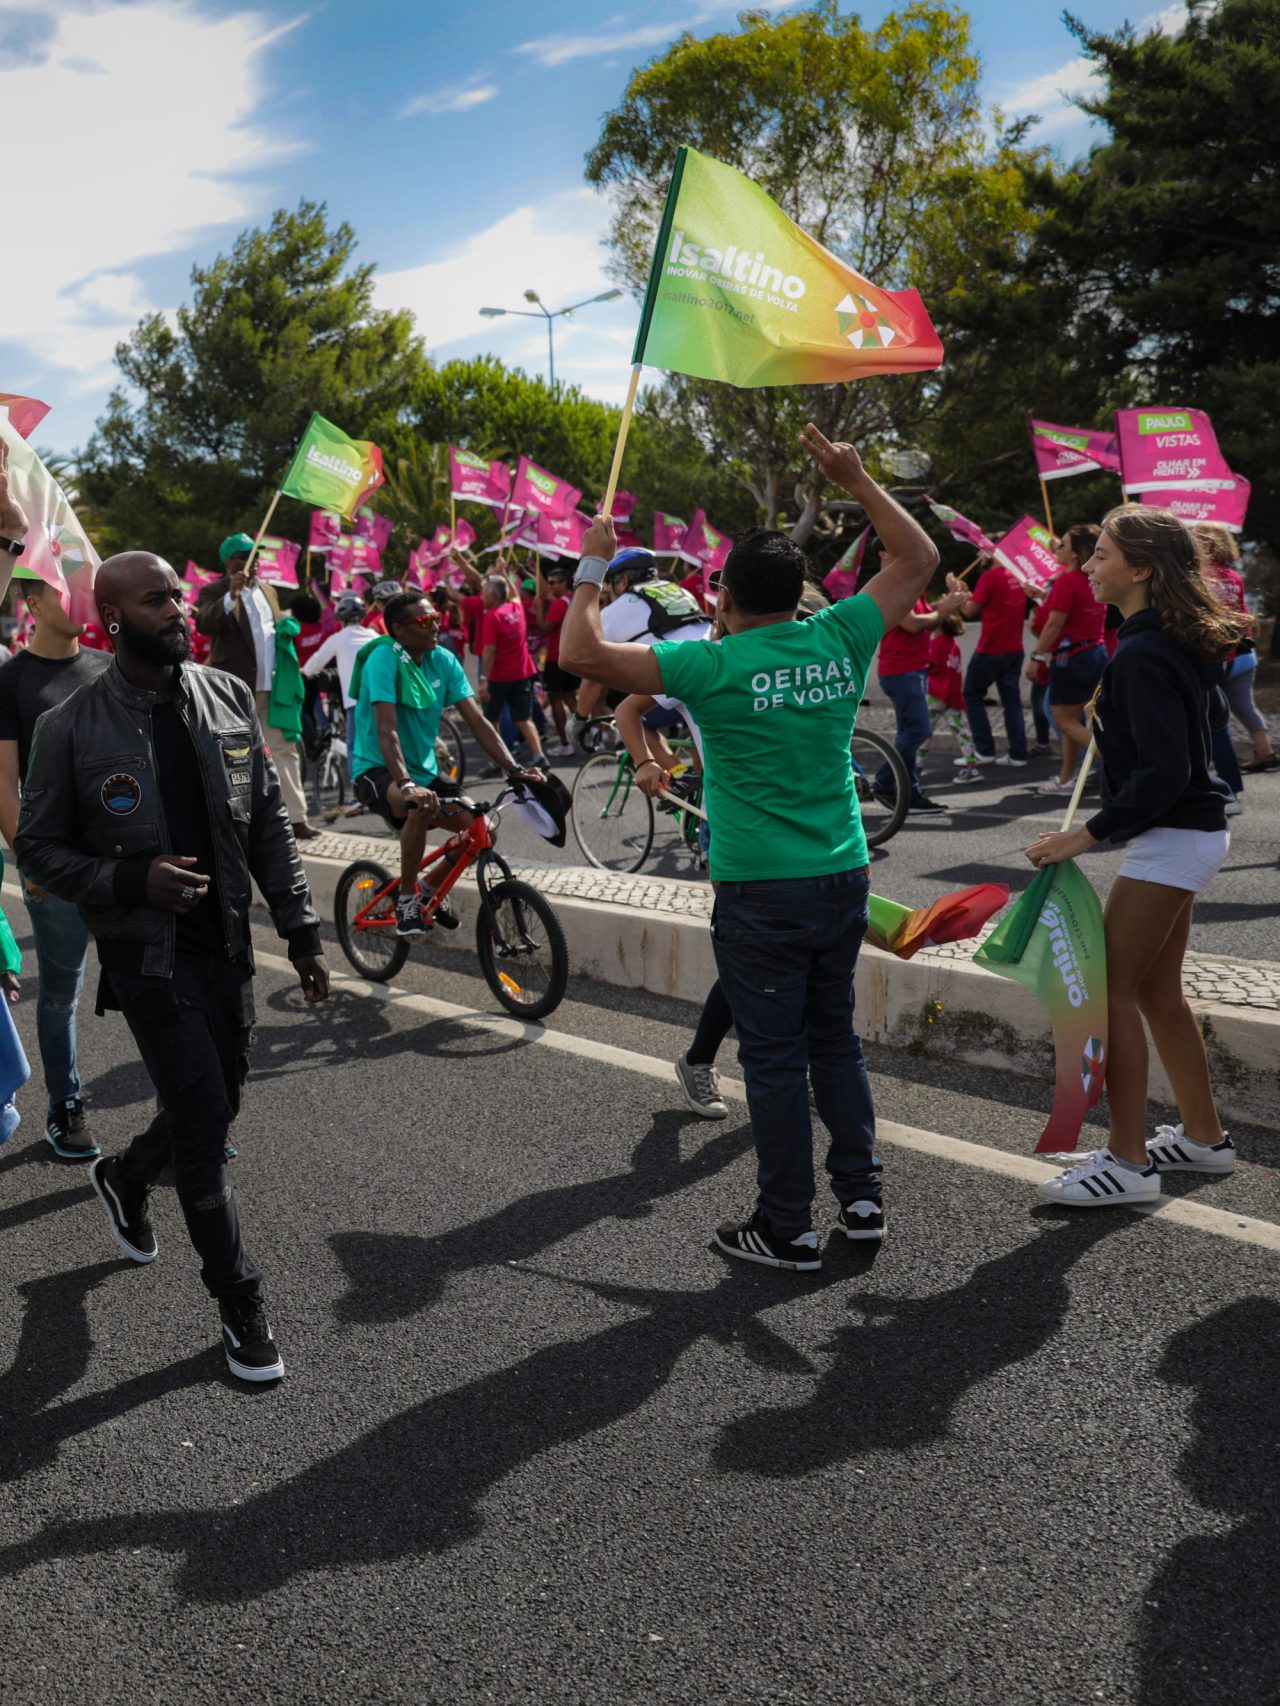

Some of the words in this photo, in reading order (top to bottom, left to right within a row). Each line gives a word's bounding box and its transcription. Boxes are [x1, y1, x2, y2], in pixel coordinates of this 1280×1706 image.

[669, 230, 806, 299] Isaltino
[667, 266, 707, 281] INOVAR
[710, 276, 747, 295] OEIRAS
[749, 288, 765, 300] DE
[767, 294, 799, 313] VOLTA
[1145, 416, 1186, 430] PAULO
[1155, 434, 1201, 449] VISTAS
[307, 444, 363, 481] Isaltino
[1152, 466, 1187, 477] FRENTE
[1157, 458, 1190, 470] OLHAR
[1192, 457, 1207, 468] EM
[751, 657, 852, 693] OEIRAS
[753, 693, 784, 712] DE
[792, 680, 857, 706] VOLTA
